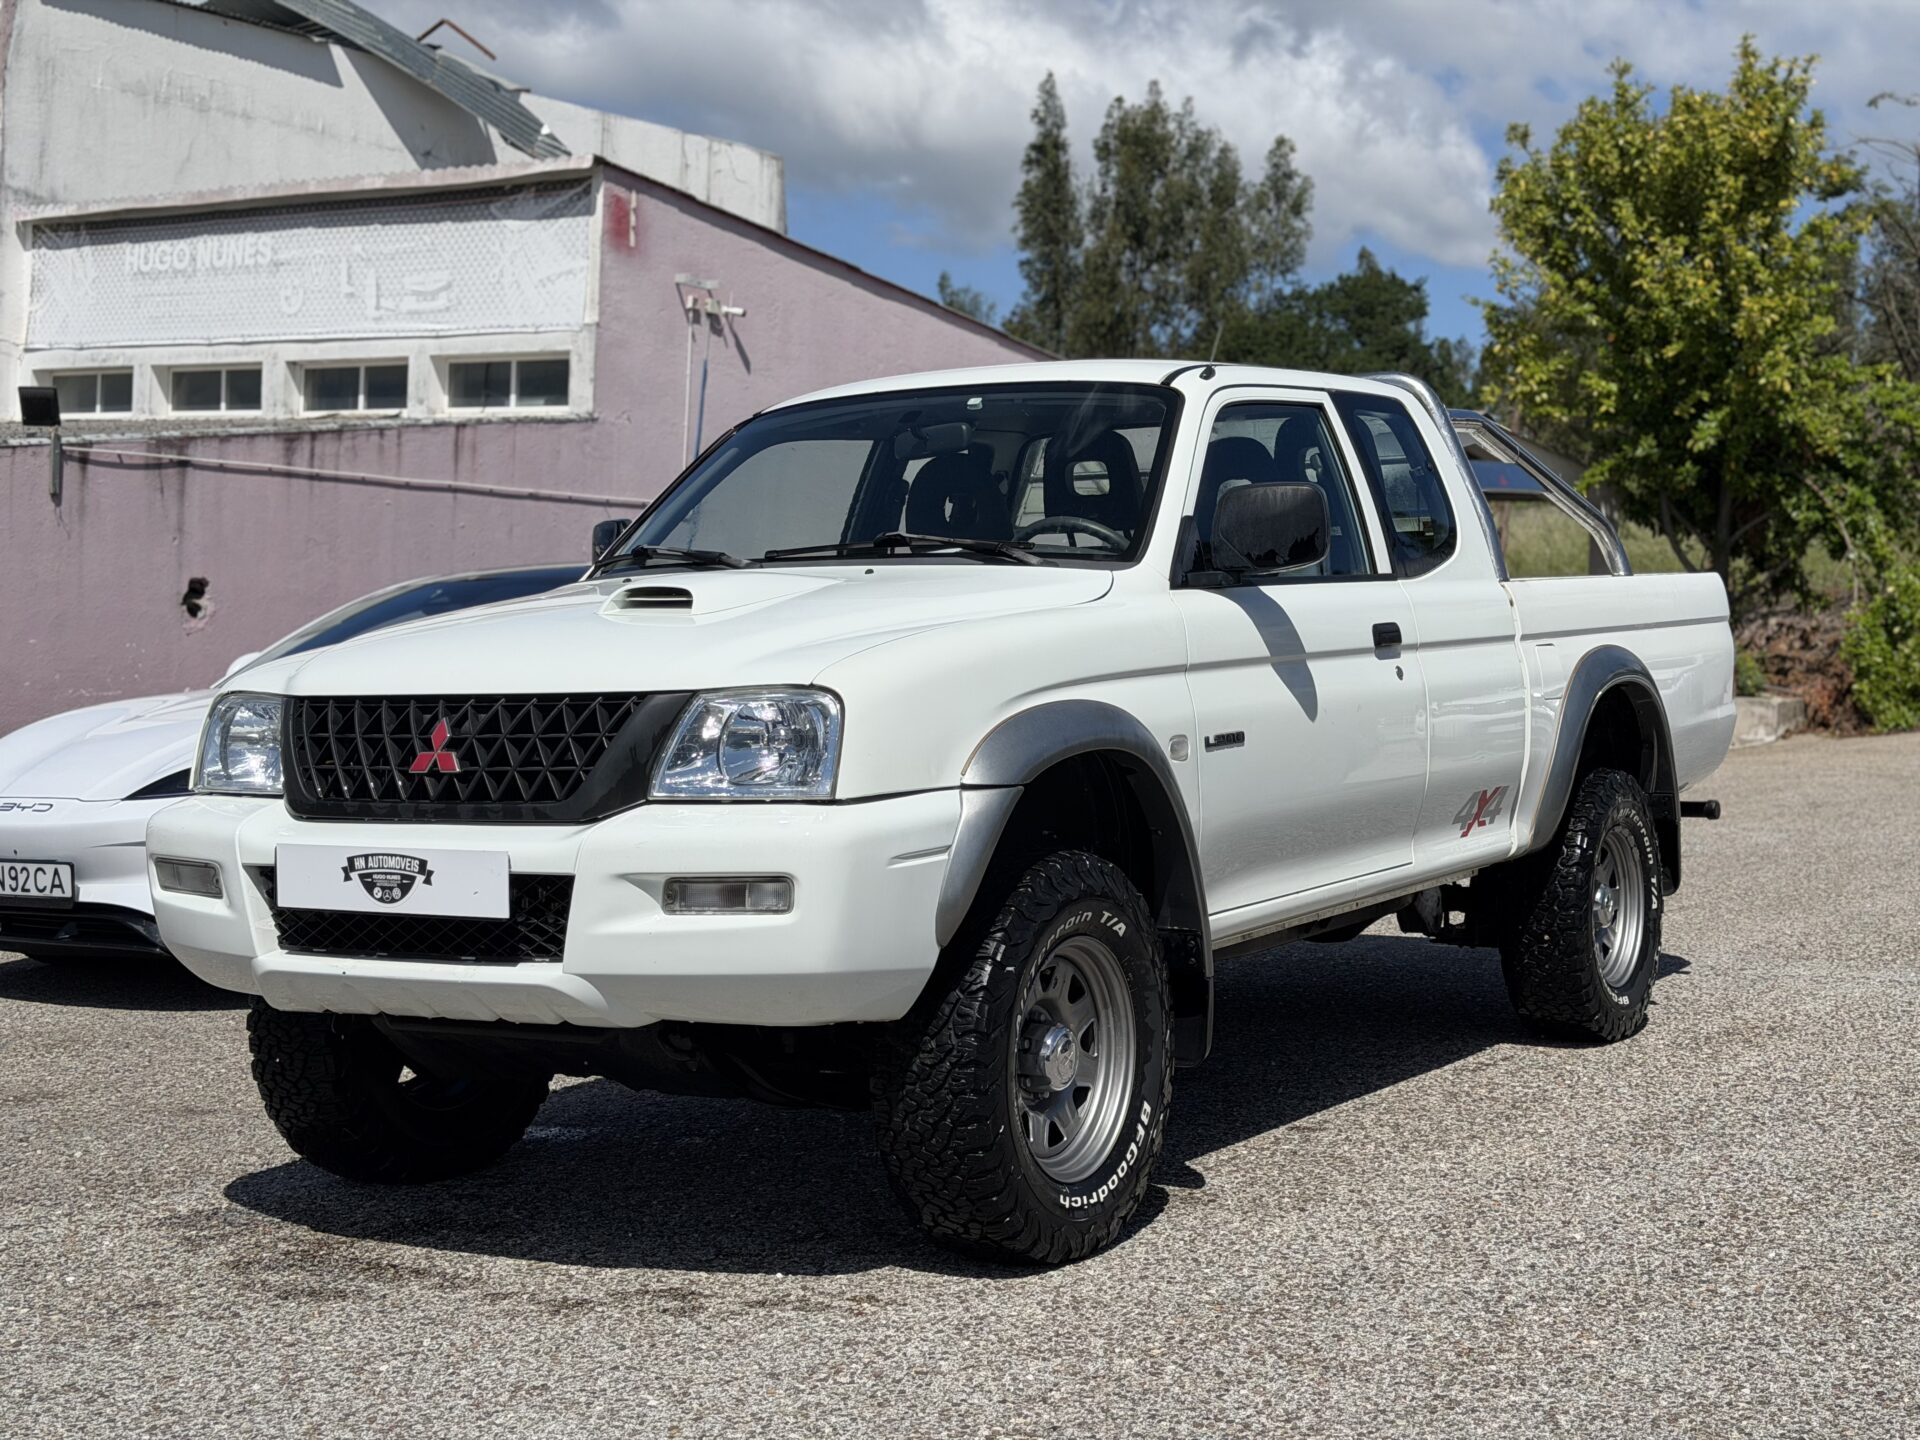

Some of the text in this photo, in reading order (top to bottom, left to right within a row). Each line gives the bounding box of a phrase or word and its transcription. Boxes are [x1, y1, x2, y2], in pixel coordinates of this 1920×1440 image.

[125, 235, 272, 273] HUGO NUNES
[1204, 731, 1245, 752] L200
[0, 802, 54, 813] BYD
[354, 855, 420, 873] HN AUTOMOVEIS
[1099, 910, 1127, 938] T/A
[1059, 1100, 1151, 1209] BFGoodrich
